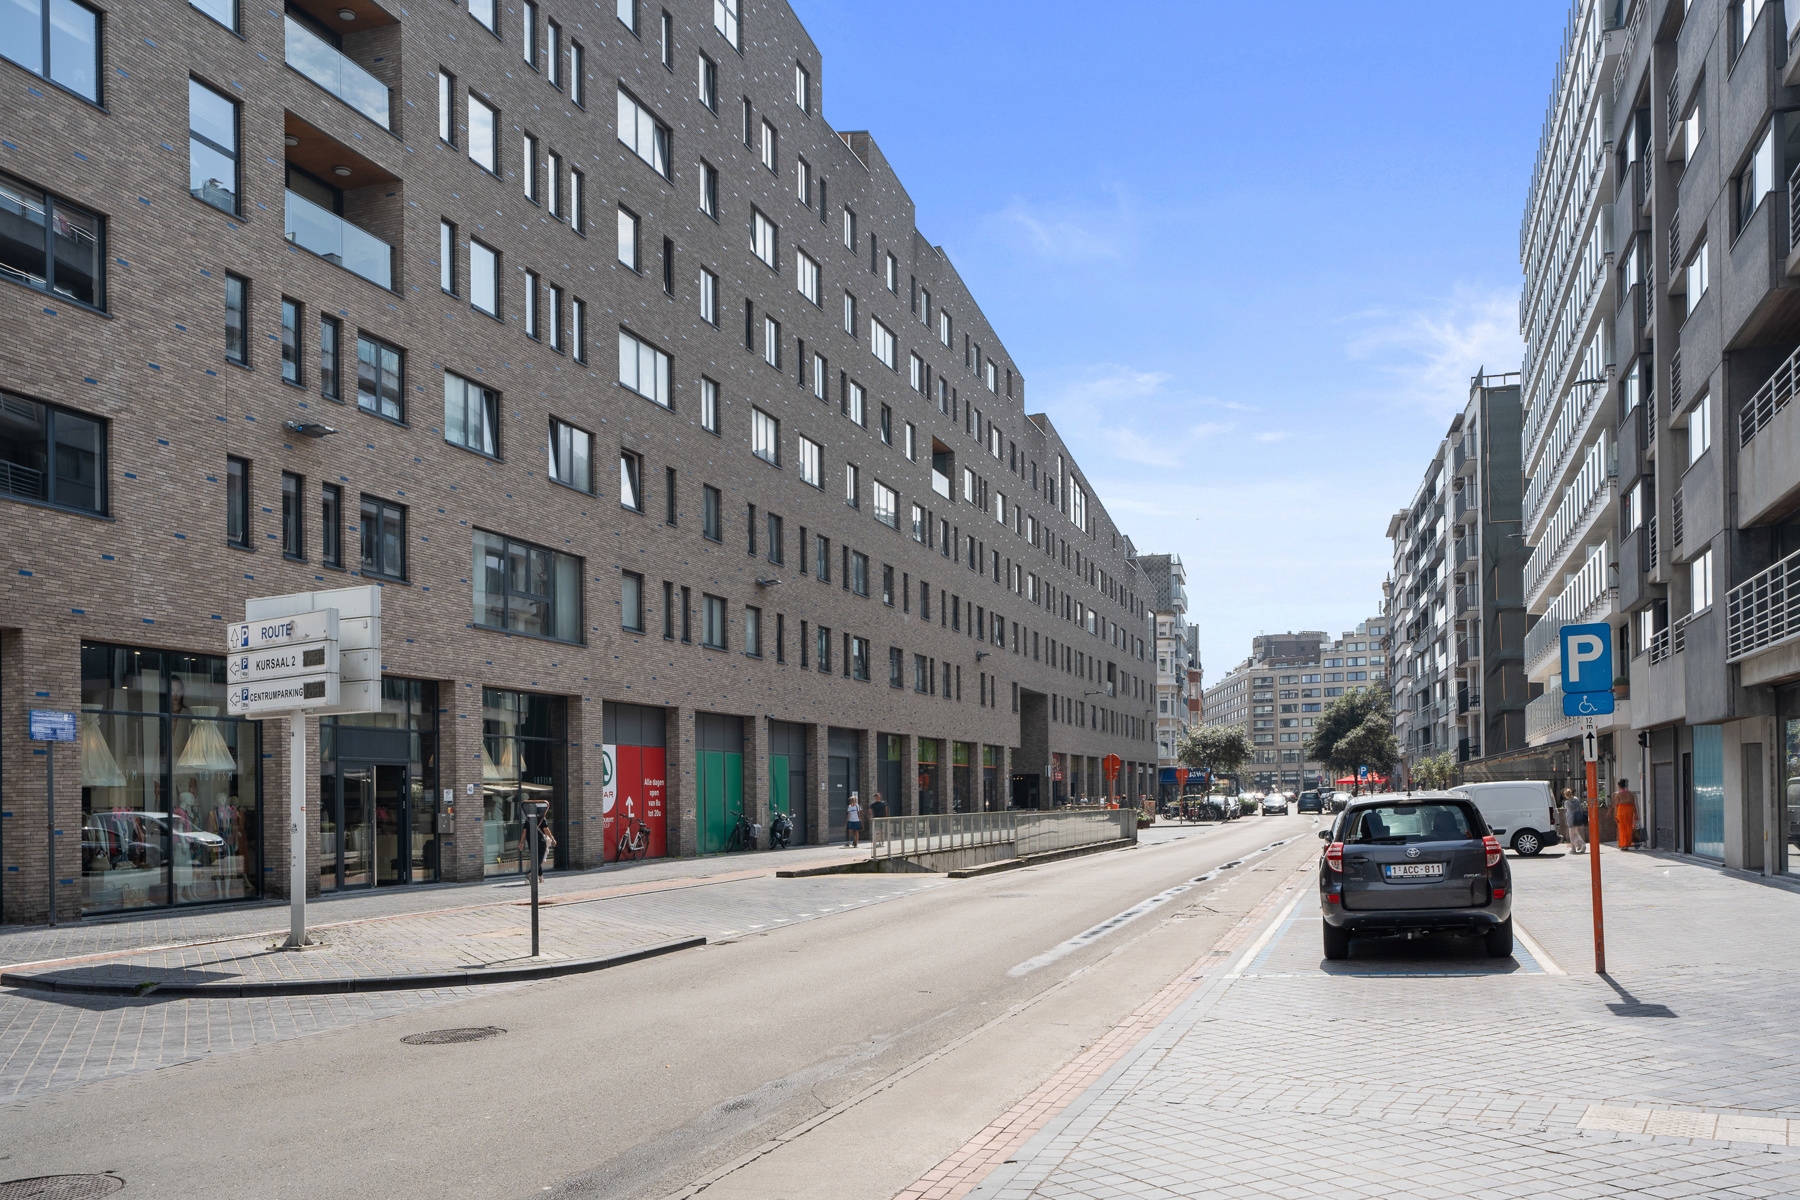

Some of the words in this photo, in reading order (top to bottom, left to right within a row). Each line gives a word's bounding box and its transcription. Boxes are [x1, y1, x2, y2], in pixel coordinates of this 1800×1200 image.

[261, 623, 291, 639] ROUTE
[256, 657, 290, 670] KURSAAL
[291, 656, 295, 666] 2
[1567, 634, 1604, 683] P
[250, 688, 303, 701] CENTRUMPARKING
[644, 778, 652, 786] Alle
[653, 779, 664, 787] dagen
